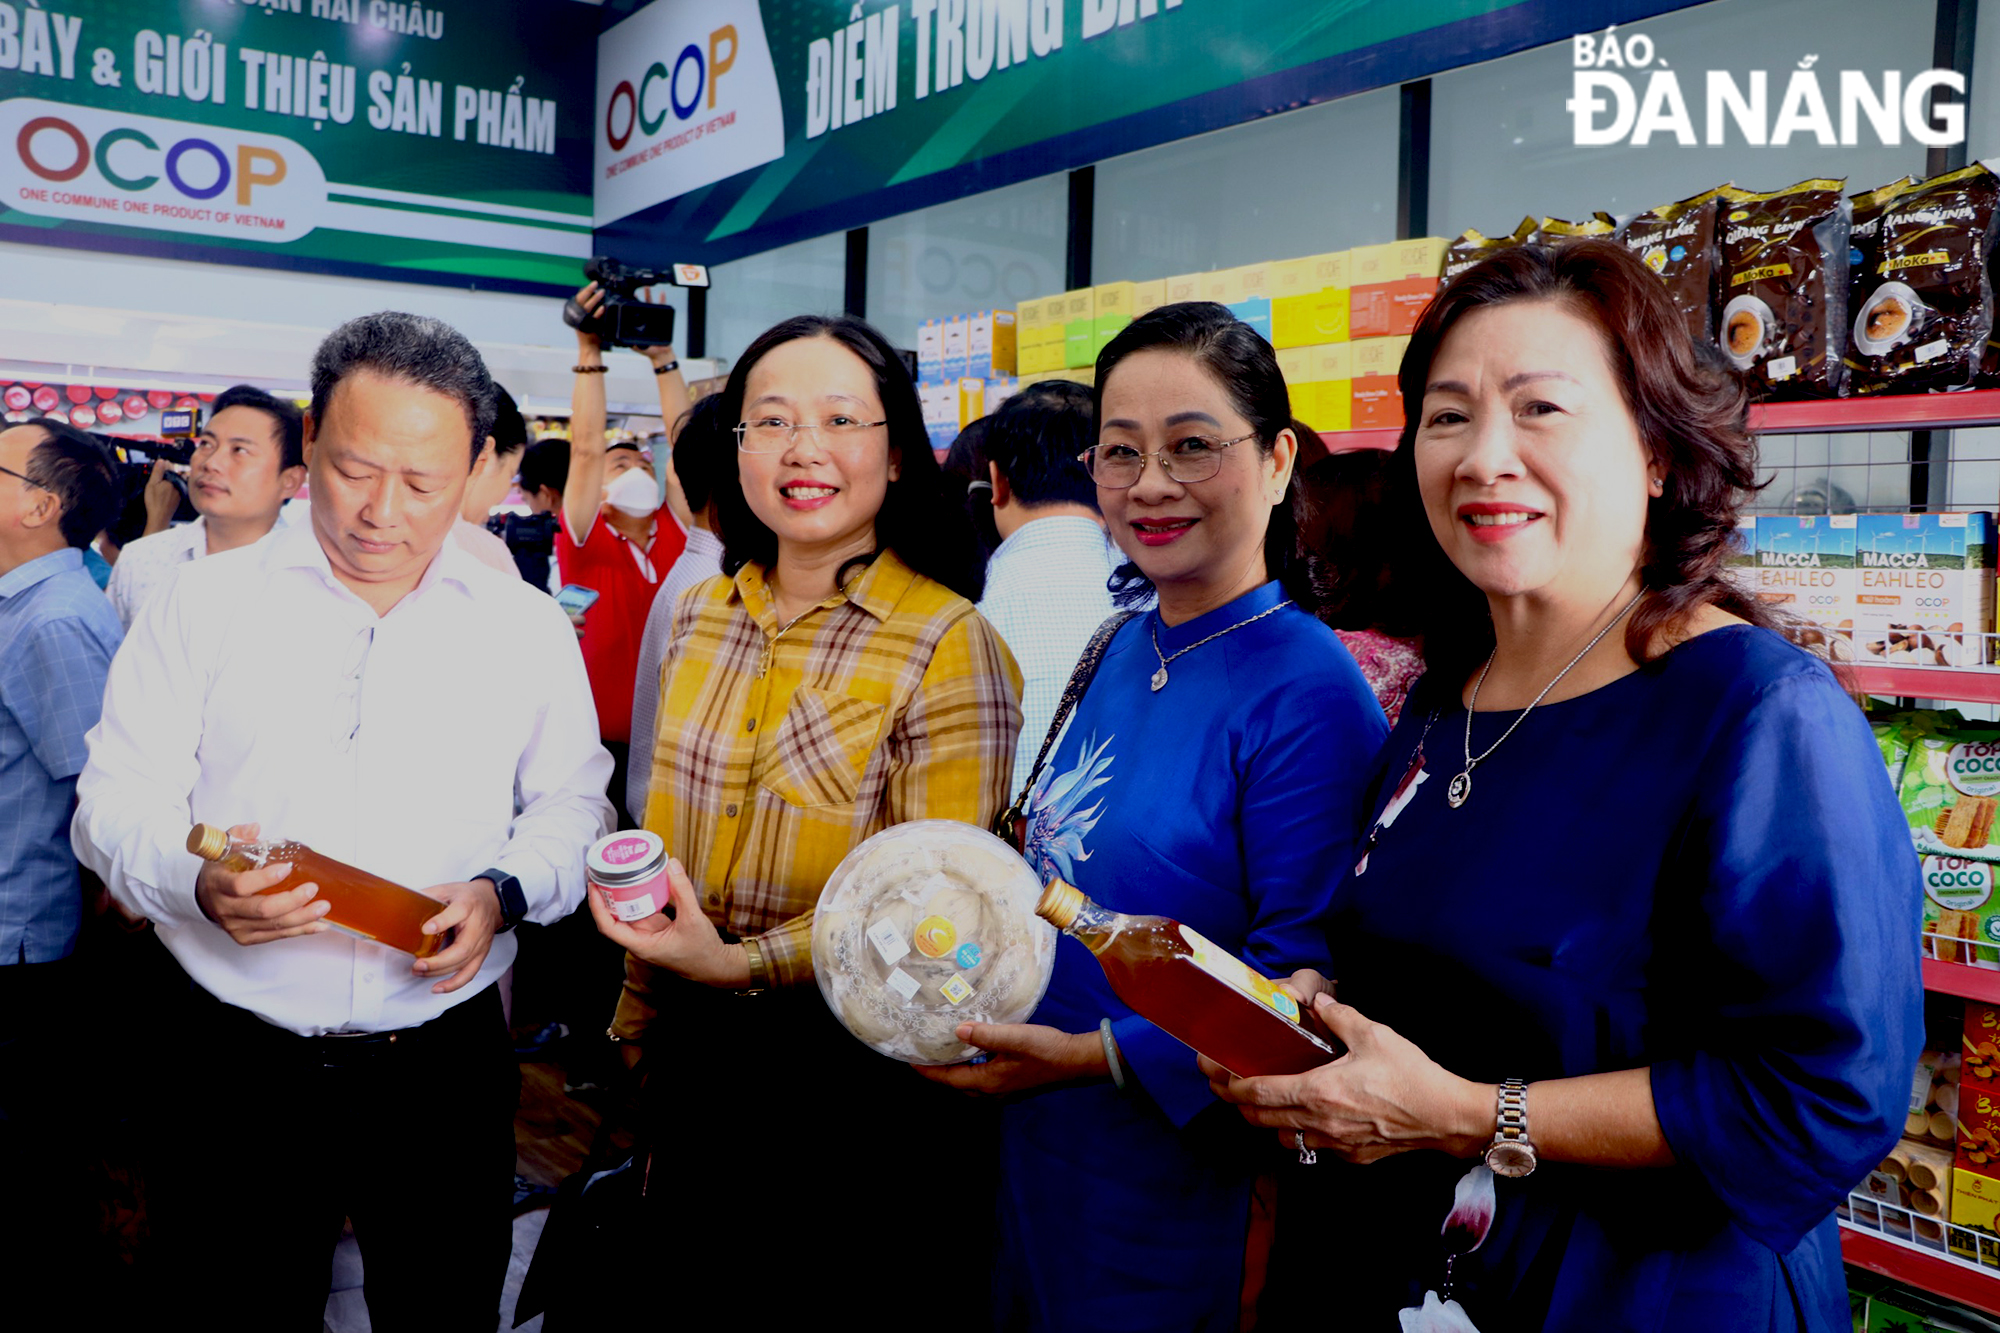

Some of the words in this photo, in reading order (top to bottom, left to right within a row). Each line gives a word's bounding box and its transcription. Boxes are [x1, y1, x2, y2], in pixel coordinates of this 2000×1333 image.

[369, 0, 444, 40] CHÂU
[91, 47, 121, 88] &
[134, 29, 226, 104] GIỚI
[240, 48, 356, 131] THIỆU
[368, 62, 442, 138] SẢN
[454, 75, 557, 155] PHẨM
[606, 23, 739, 152] OCOP
[16, 116, 288, 206] OCOP
[19, 187, 49, 203] ONE
[52, 191, 120, 211] COMMUNE
[123, 200, 150, 215] ONE
[153, 204, 212, 222] PRODUCT
[215, 212, 231, 224] OF
[234, 213, 286, 230] VIETNAM
[1725, 224, 1770, 245] QUANG
[1892, 256, 1930, 269] MoKa
[1743, 268, 1774, 281] MoKa
[1761, 552, 1821, 568] MACCA
[1863, 552, 1929, 568] MACCA
[1761, 570, 1836, 588] EAHLEO
[1863, 570, 1944, 589] EAHLEO
[1809, 595, 1841, 605] OCOP
[1915, 597, 1950, 607] OCOP
[1928, 871, 1985, 887] COCO
